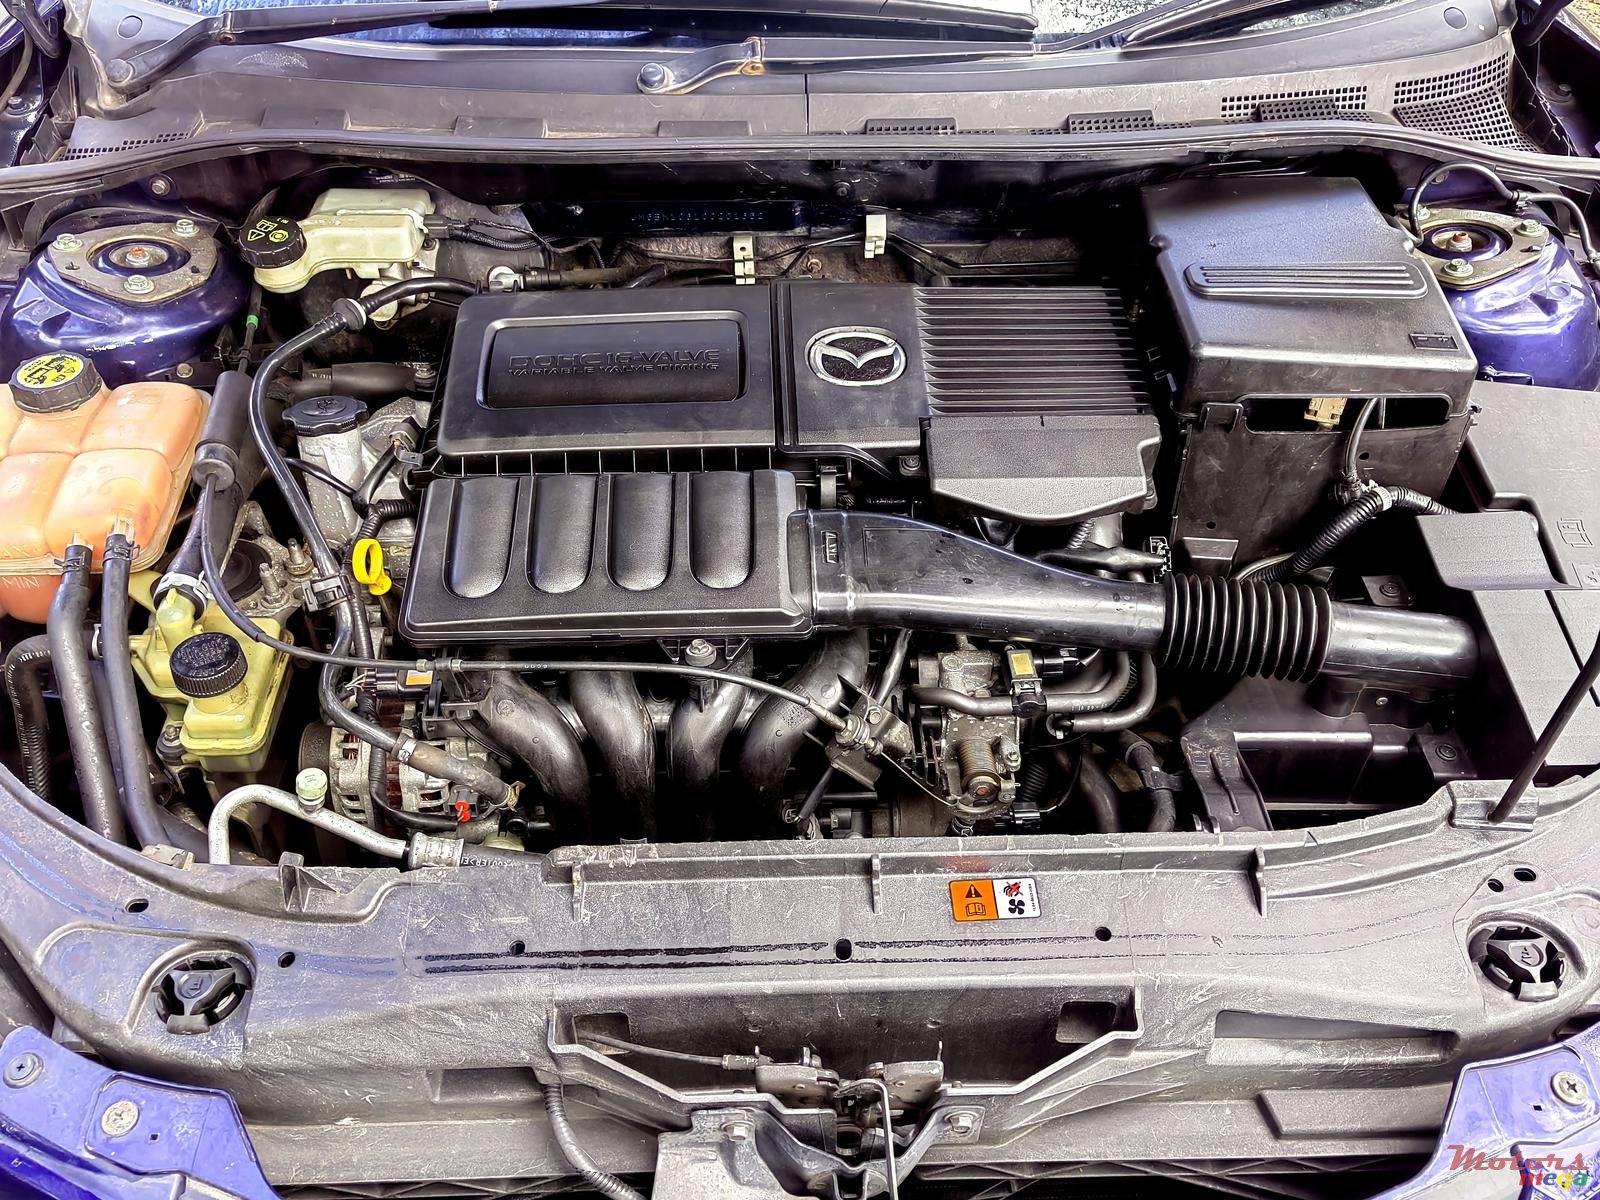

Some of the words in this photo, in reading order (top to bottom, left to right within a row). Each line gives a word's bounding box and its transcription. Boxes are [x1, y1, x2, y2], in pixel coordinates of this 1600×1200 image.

[509, 352, 601, 367] DOHC
[606, 349, 720, 365] 16-VALVE
[508, 367, 595, 376] VARIABLE
[600, 365, 654, 374] VALVE
[657, 363, 719, 372] TIMING
